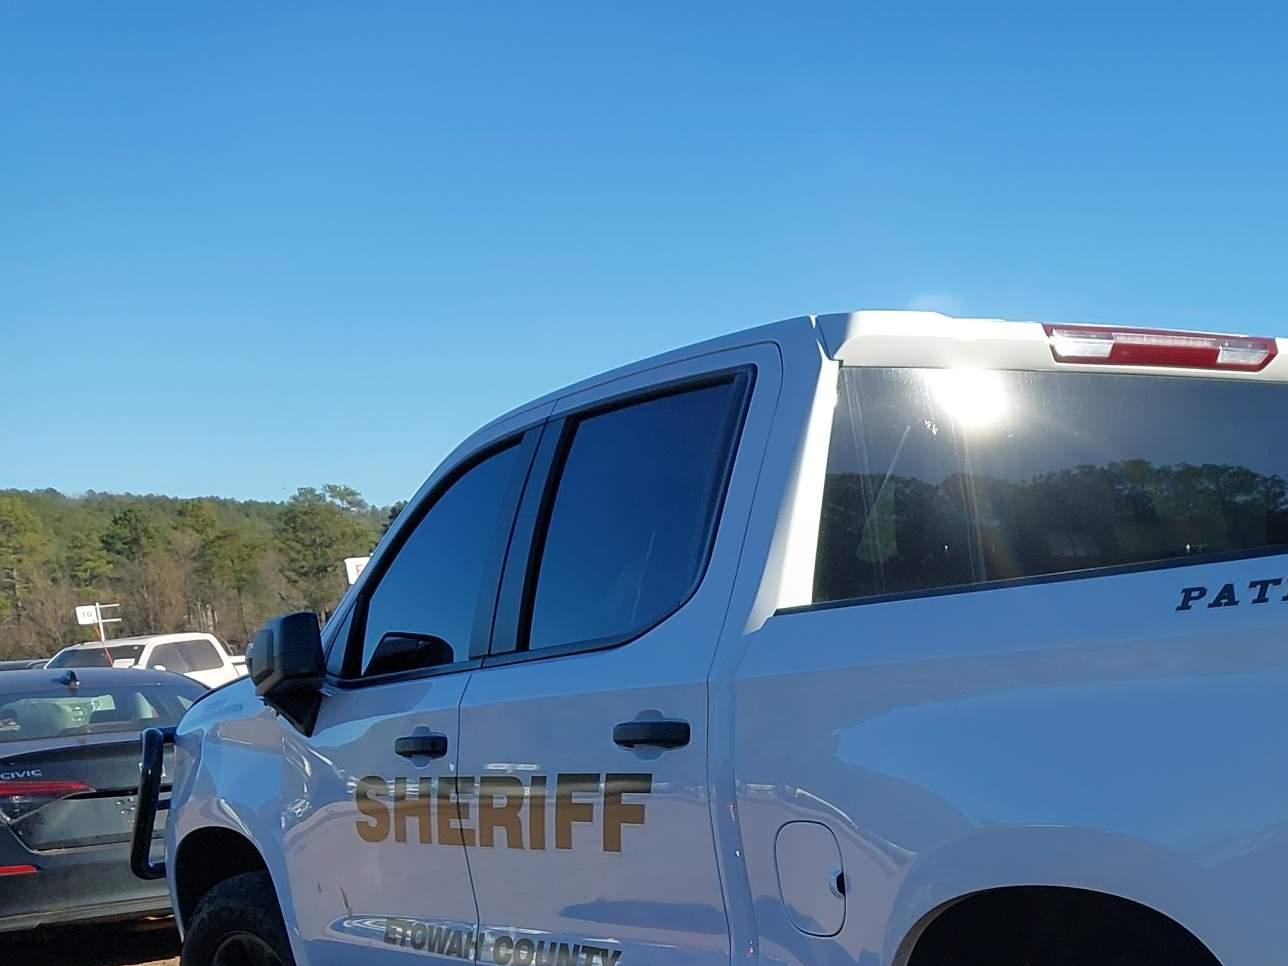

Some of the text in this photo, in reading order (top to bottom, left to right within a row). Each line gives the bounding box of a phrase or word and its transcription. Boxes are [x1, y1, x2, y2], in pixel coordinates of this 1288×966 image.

[0, 768, 43, 781] CIVIC
[354, 772, 653, 853] SHERIFF
[383, 916, 486, 962] ETOWAH
